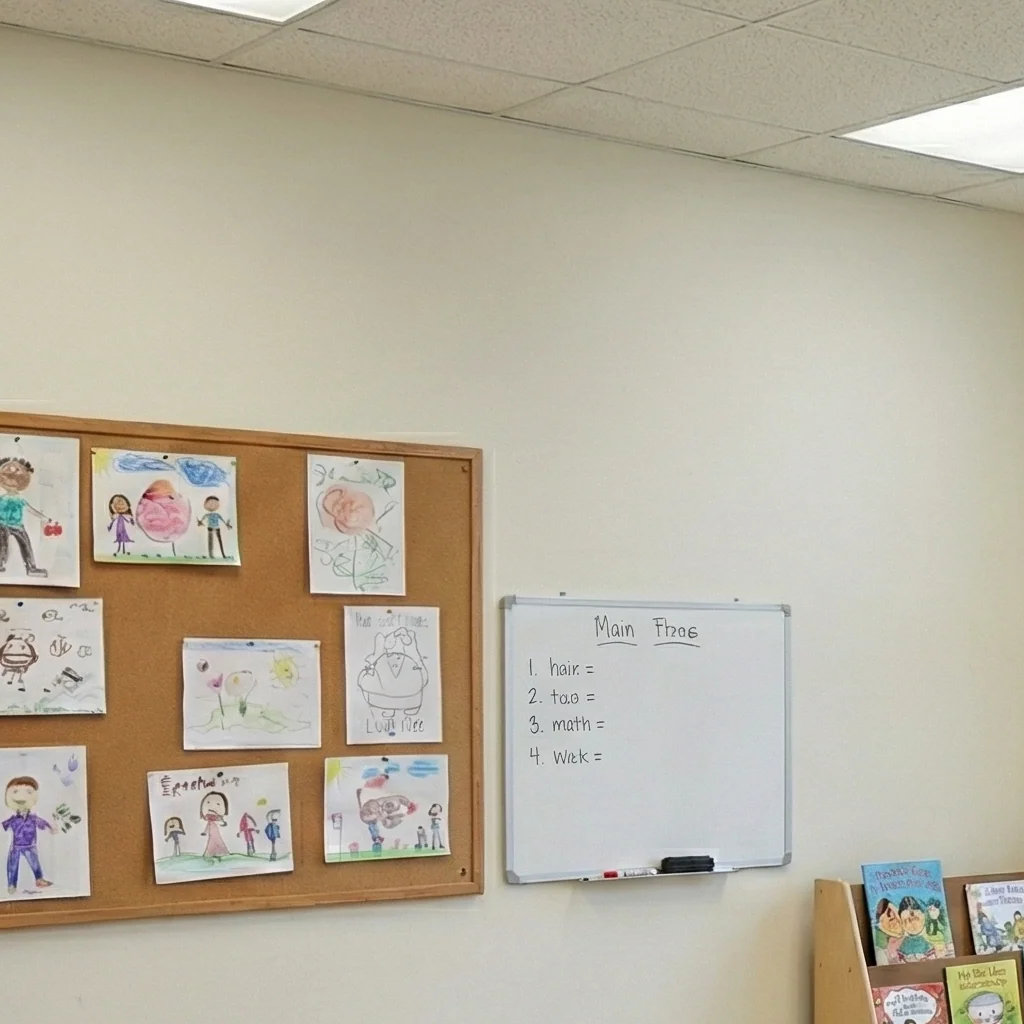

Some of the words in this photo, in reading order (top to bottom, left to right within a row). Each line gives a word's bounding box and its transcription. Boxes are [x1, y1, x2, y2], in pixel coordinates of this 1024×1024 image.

[594, 615, 635, 638] Main
[529, 658, 538, 676] 1.
[528, 687, 543, 705] 2.
[529, 715, 544, 734] 3.
[552, 715, 591, 732] math
[530, 746, 544, 766] 4.
